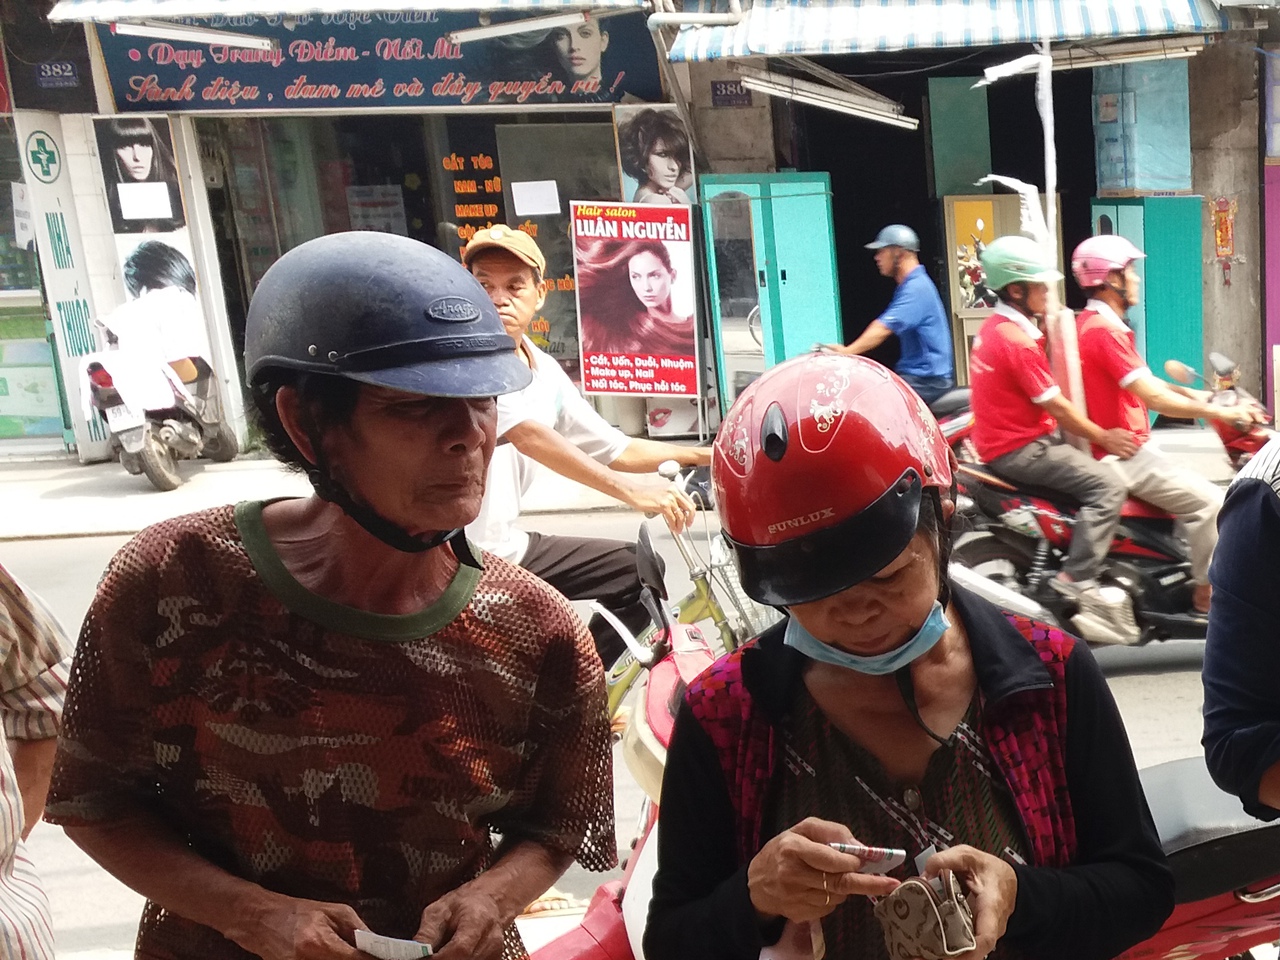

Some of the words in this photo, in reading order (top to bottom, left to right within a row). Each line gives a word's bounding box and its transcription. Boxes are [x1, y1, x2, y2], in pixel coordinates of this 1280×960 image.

[148, 43, 206, 69] Dạy
[41, 63, 73, 77] 382
[284, 75, 340, 99] đam
[345, 78, 385, 98] mê
[393, 78, 425, 97] và
[716, 83, 747, 96] 380
[454, 180, 477, 193] NAM
[455, 204, 483, 217] MAKE
[484, 204, 498, 217] UP
[576, 205, 603, 217] Hair
[605, 206, 637, 218] salon
[575, 216, 618, 238] LUÂN
[621, 216, 687, 241] NGUYỄN
[590, 367, 616, 378] Make
[635, 369, 655, 379] Nail
[767, 507, 836, 534] SUNLUX
